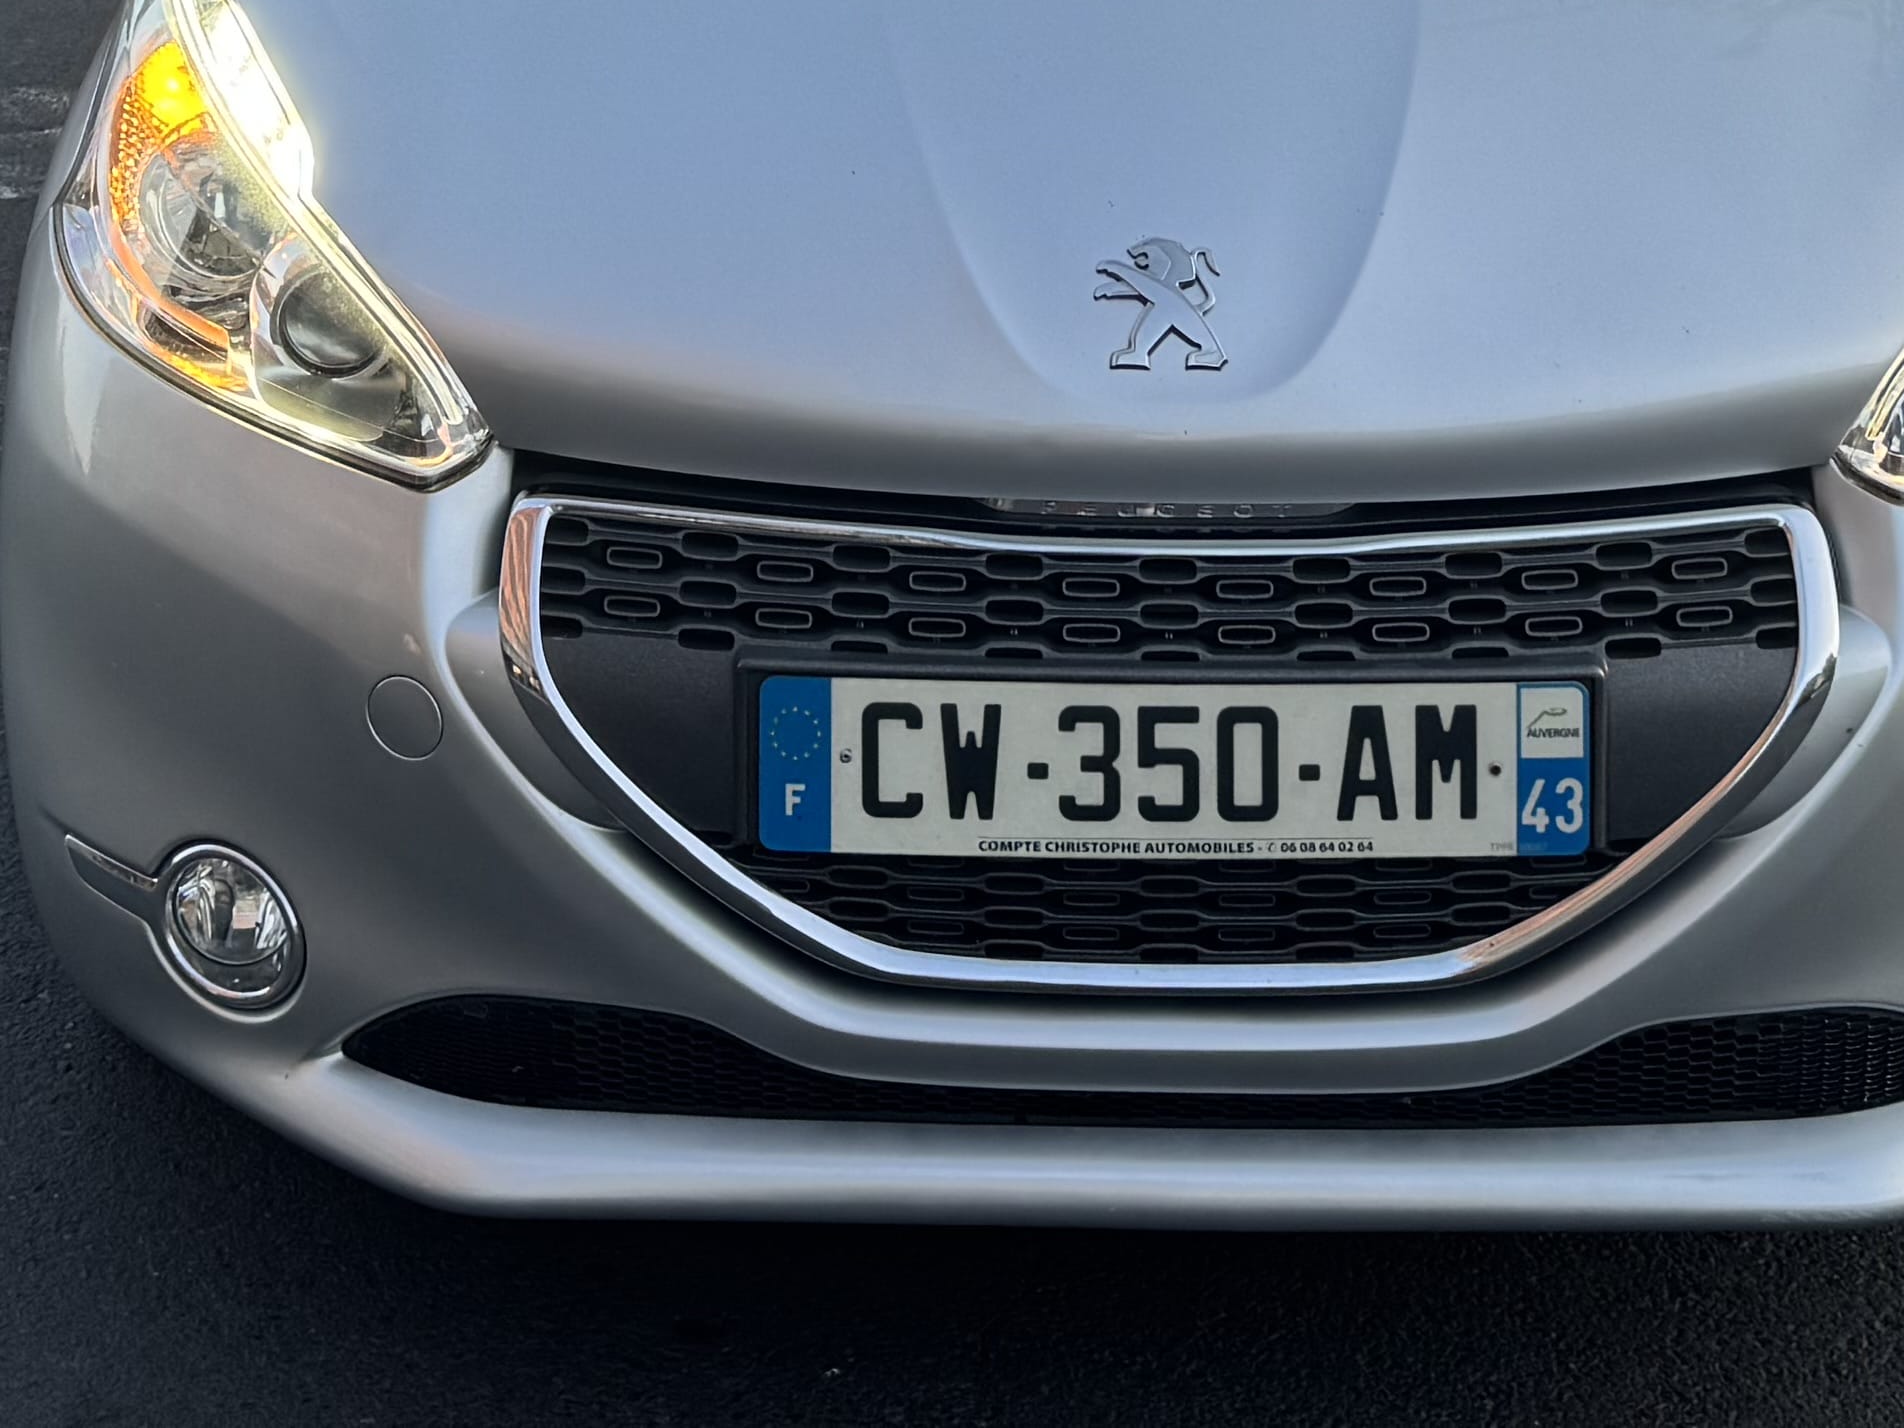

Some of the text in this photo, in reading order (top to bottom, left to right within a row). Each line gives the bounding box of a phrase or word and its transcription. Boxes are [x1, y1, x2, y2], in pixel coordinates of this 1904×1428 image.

[1526, 727, 1580, 739] AUVERGNE
[861, 701, 1477, 822] CW-350-AM
[785, 783, 806, 816] F
[1521, 777, 1584, 834] 43
[978, 840, 1041, 852] COMPTE
[1044, 841, 1141, 854] CHRISTOPHE
[1144, 842, 1255, 854] AUTOMOBILES
[1280, 842, 1297, 853] 06
[1299, 842, 1316, 853] 08
[1319, 841, 1335, 853] 64
[1338, 841, 1354, 853] 02
